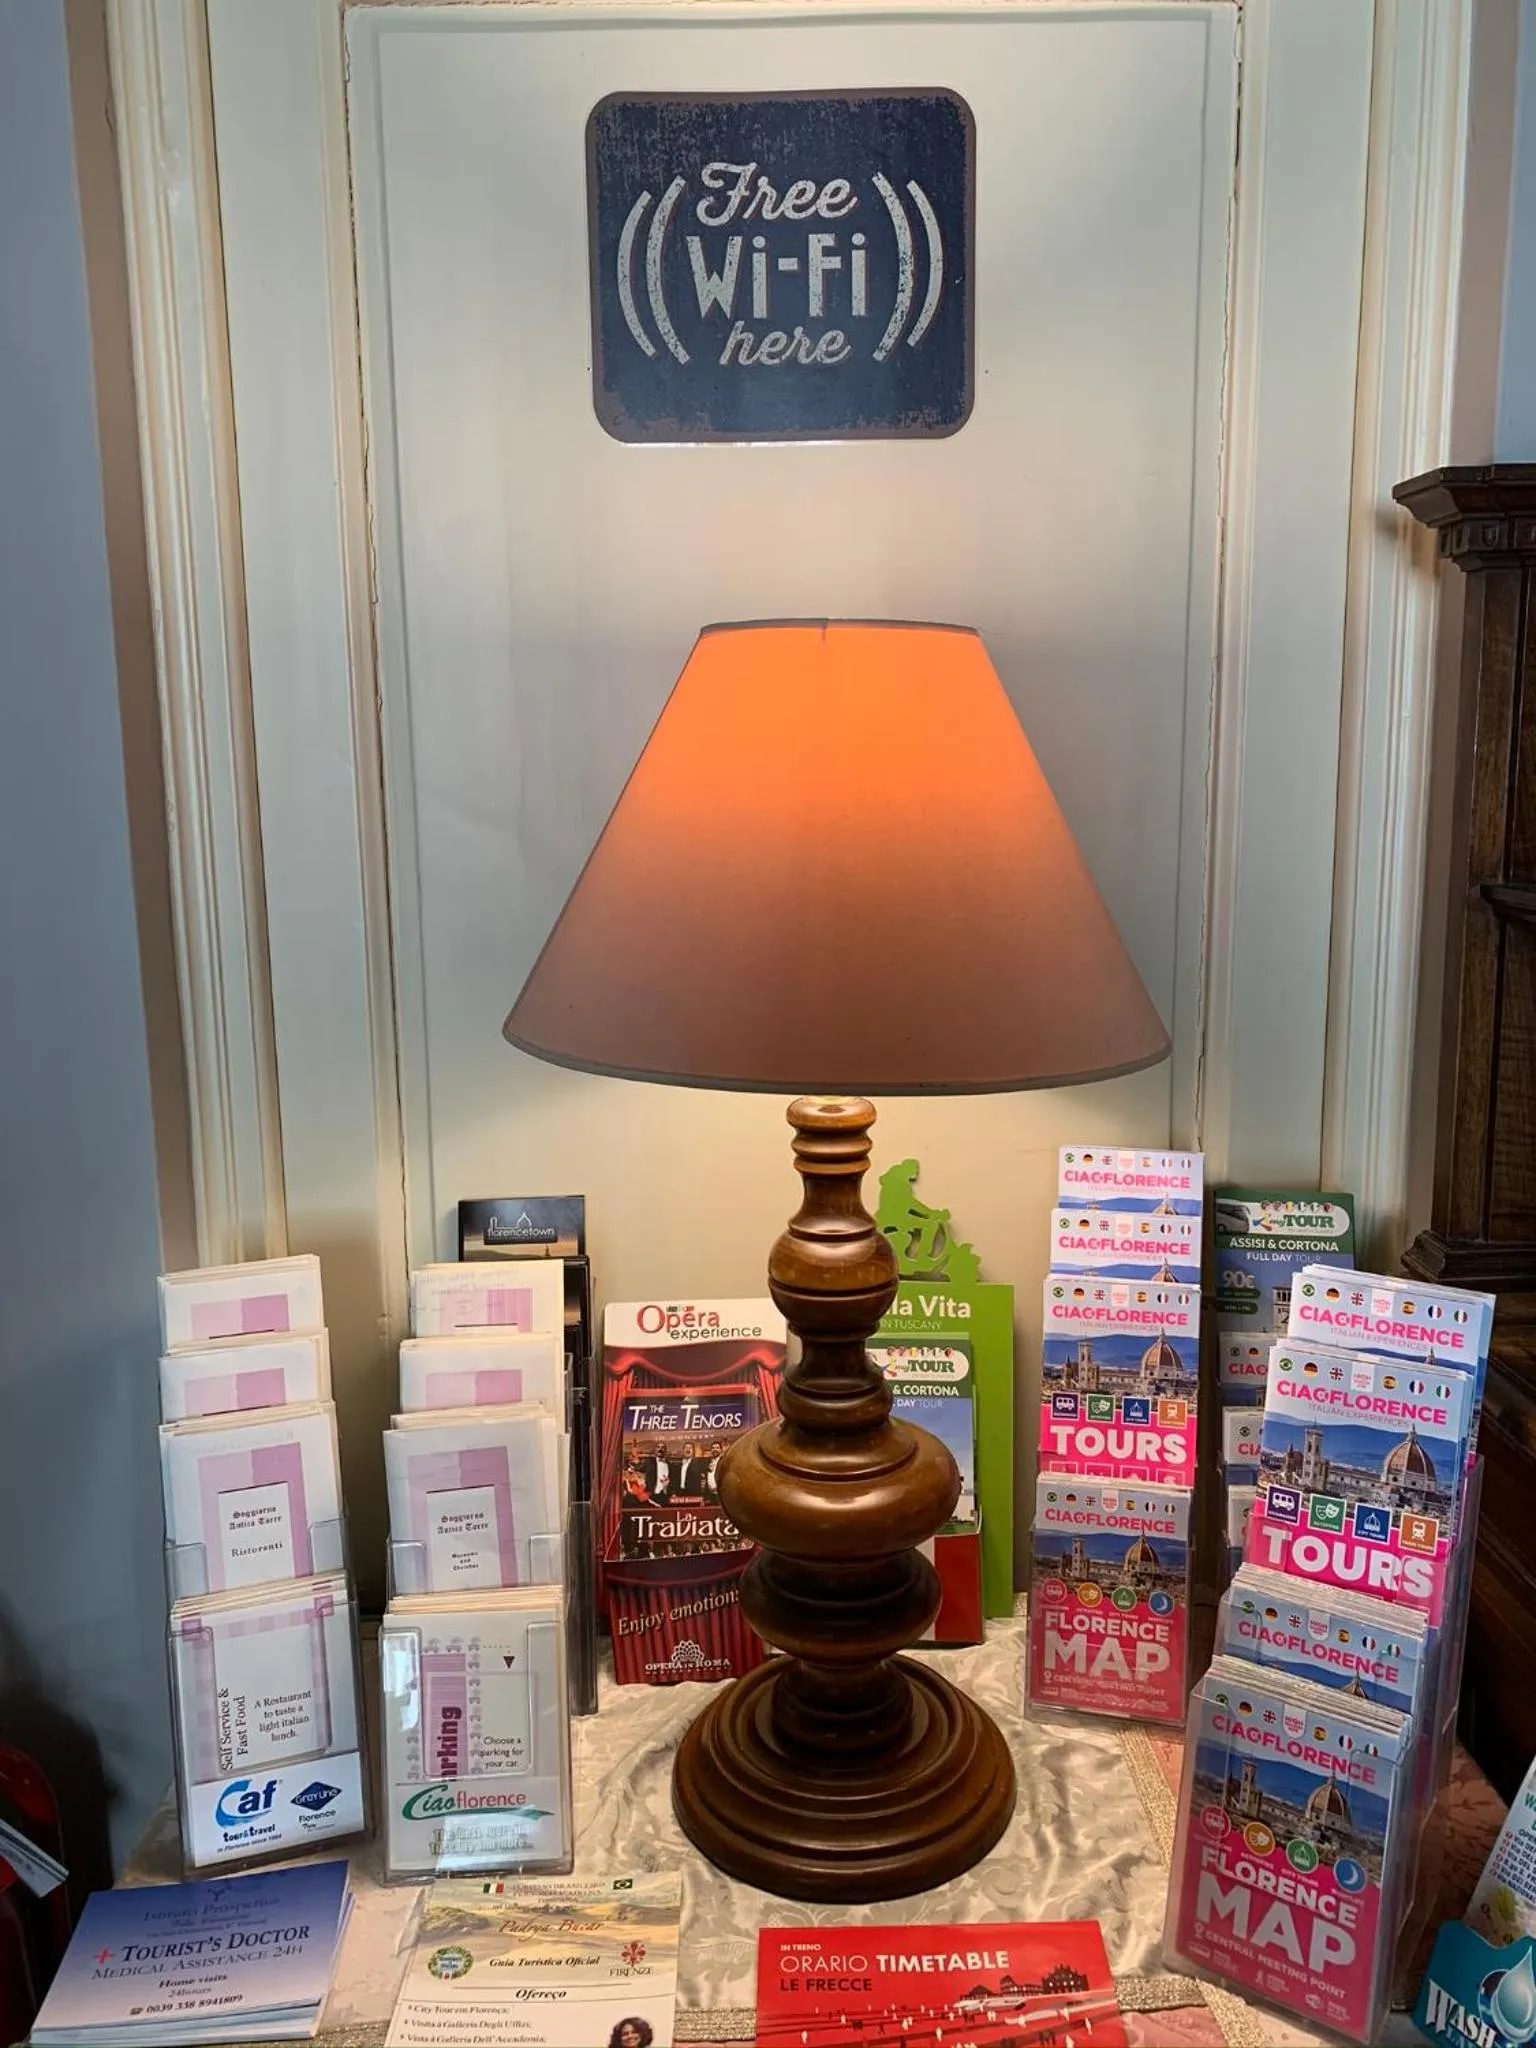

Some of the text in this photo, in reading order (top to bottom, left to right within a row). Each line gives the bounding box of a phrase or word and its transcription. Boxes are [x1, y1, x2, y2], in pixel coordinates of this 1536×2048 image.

[696, 162, 858, 227] Free
[686, 233, 867, 320] Wi-Fi
[719, 320, 852, 366] here
[1230, 1238, 1339, 1252] ASSISI & CORTONA
[1246, 1252, 1270, 1261] FULL
[1271, 1253, 1292, 1261] DAY
[919, 1295, 971, 1318] Vita
[670, 1326, 762, 1340] experience
[895, 1320, 941, 1330] TUSCANY
[903, 1385, 959, 1396] CORTONA
[897, 1399, 915, 1407] DAY
[629, 1404, 742, 1430] THREE TENORS
[1049, 1425, 1187, 1464] TOURS
[1262, 1525, 1434, 1598] TOURS
[618, 1589, 740, 1636] Enjoy emotion
[1045, 1611, 1170, 1642] FLORENCE
[1044, 1630, 1171, 1681] MAP
[254, 1690, 312, 1709] A Restaurant
[264, 1711, 273, 1719] to
[275, 1707, 297, 1717] taste
[218, 1688, 233, 1770] Self Service &
[233, 1695, 249, 1755] Fast Food
[259, 1715, 310, 1733] light italian
[483, 1736, 515, 1745] Choose
[480, 1747, 524, 1758] parking for
[485, 1760, 503, 1769] your
[298, 1810, 337, 1822] Florence
[1201, 1847, 1359, 1930] FLORENCE
[1196, 1871, 1356, 1973] MAP
[121, 1936, 223, 1963] TOURIST'S
[229, 1925, 311, 1950] DOCTOR
[91, 1960, 167, 1980] MEDICAL
[173, 1950, 267, 1972] ASSISTANCE
[565, 1956, 601, 1968] Oficial
[780, 1951, 1010, 1973] ORARIO TIMETABLE
[1206, 1932, 1255, 1959] CENTRAL
[1258, 1954, 1308, 1983] MEETING
[1310, 1977, 1346, 1999] POINT
[159, 1973, 228, 1989] Home visits
[609, 1967, 653, 1978] FIRENZE
[516, 1989, 567, 2001] Ofereço
[780, 1978, 873, 1992] LE FRECCE
[414, 2005, 432, 2014] City
[1425, 1979, 1497, 2048] WASH
